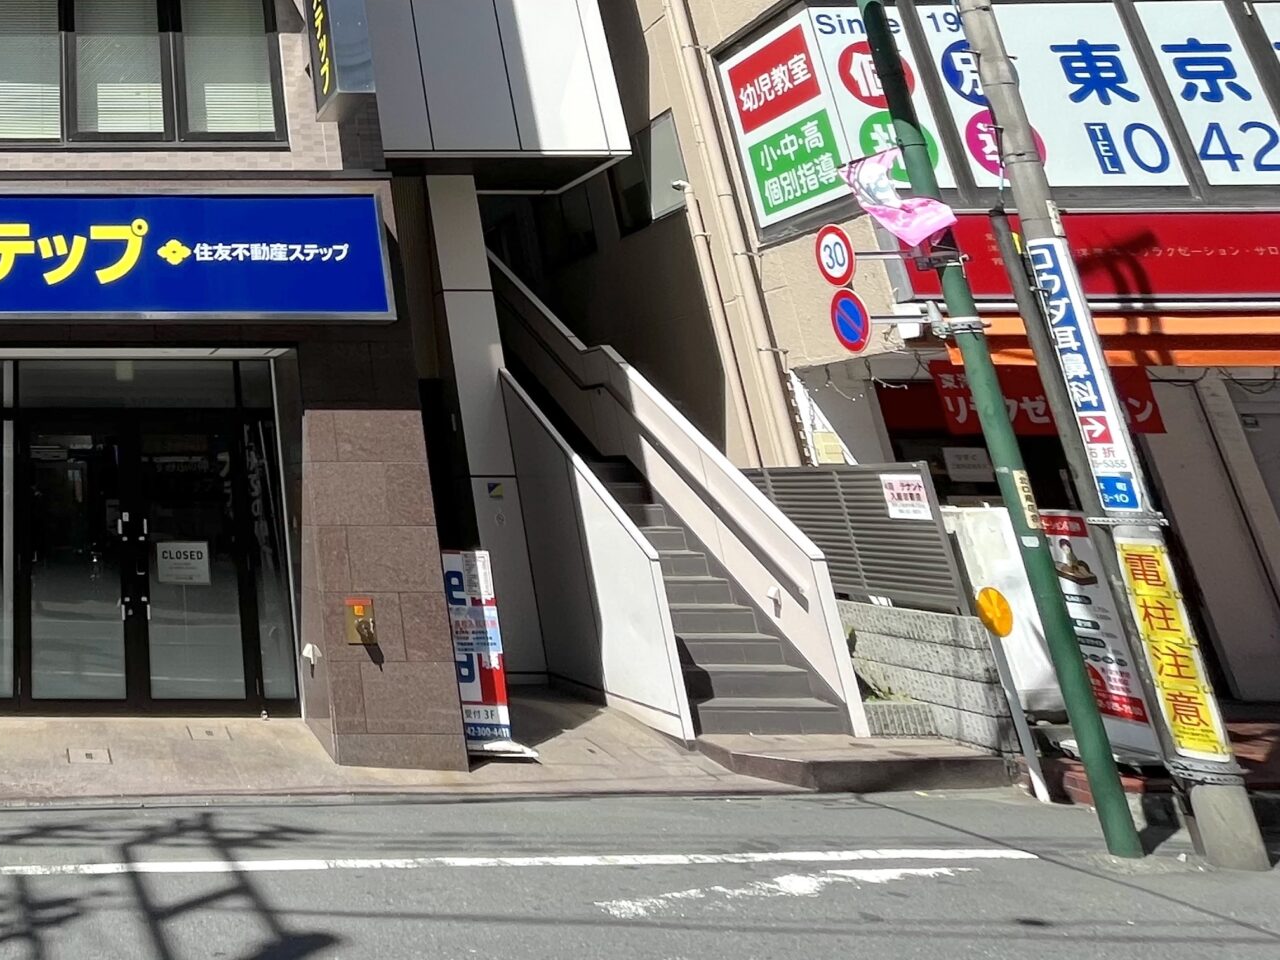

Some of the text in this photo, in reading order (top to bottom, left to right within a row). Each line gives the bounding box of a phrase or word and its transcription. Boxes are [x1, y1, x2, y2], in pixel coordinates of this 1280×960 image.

[816, 13, 901, 34] Sine
[739, 53, 812, 112] 幼児教室
[1050, 38, 1280, 105] 東京
[1089, 125, 1120, 172] TEL
[764, 152, 838, 208] 個別指導
[194, 243, 350, 263] 住友不動産ステップ
[823, 241, 846, 270] 30
[161, 550, 204, 561] CLOSED
[1125, 553, 1210, 728] 電柱注意
[467, 726, 510, 738] 42-300-4411
